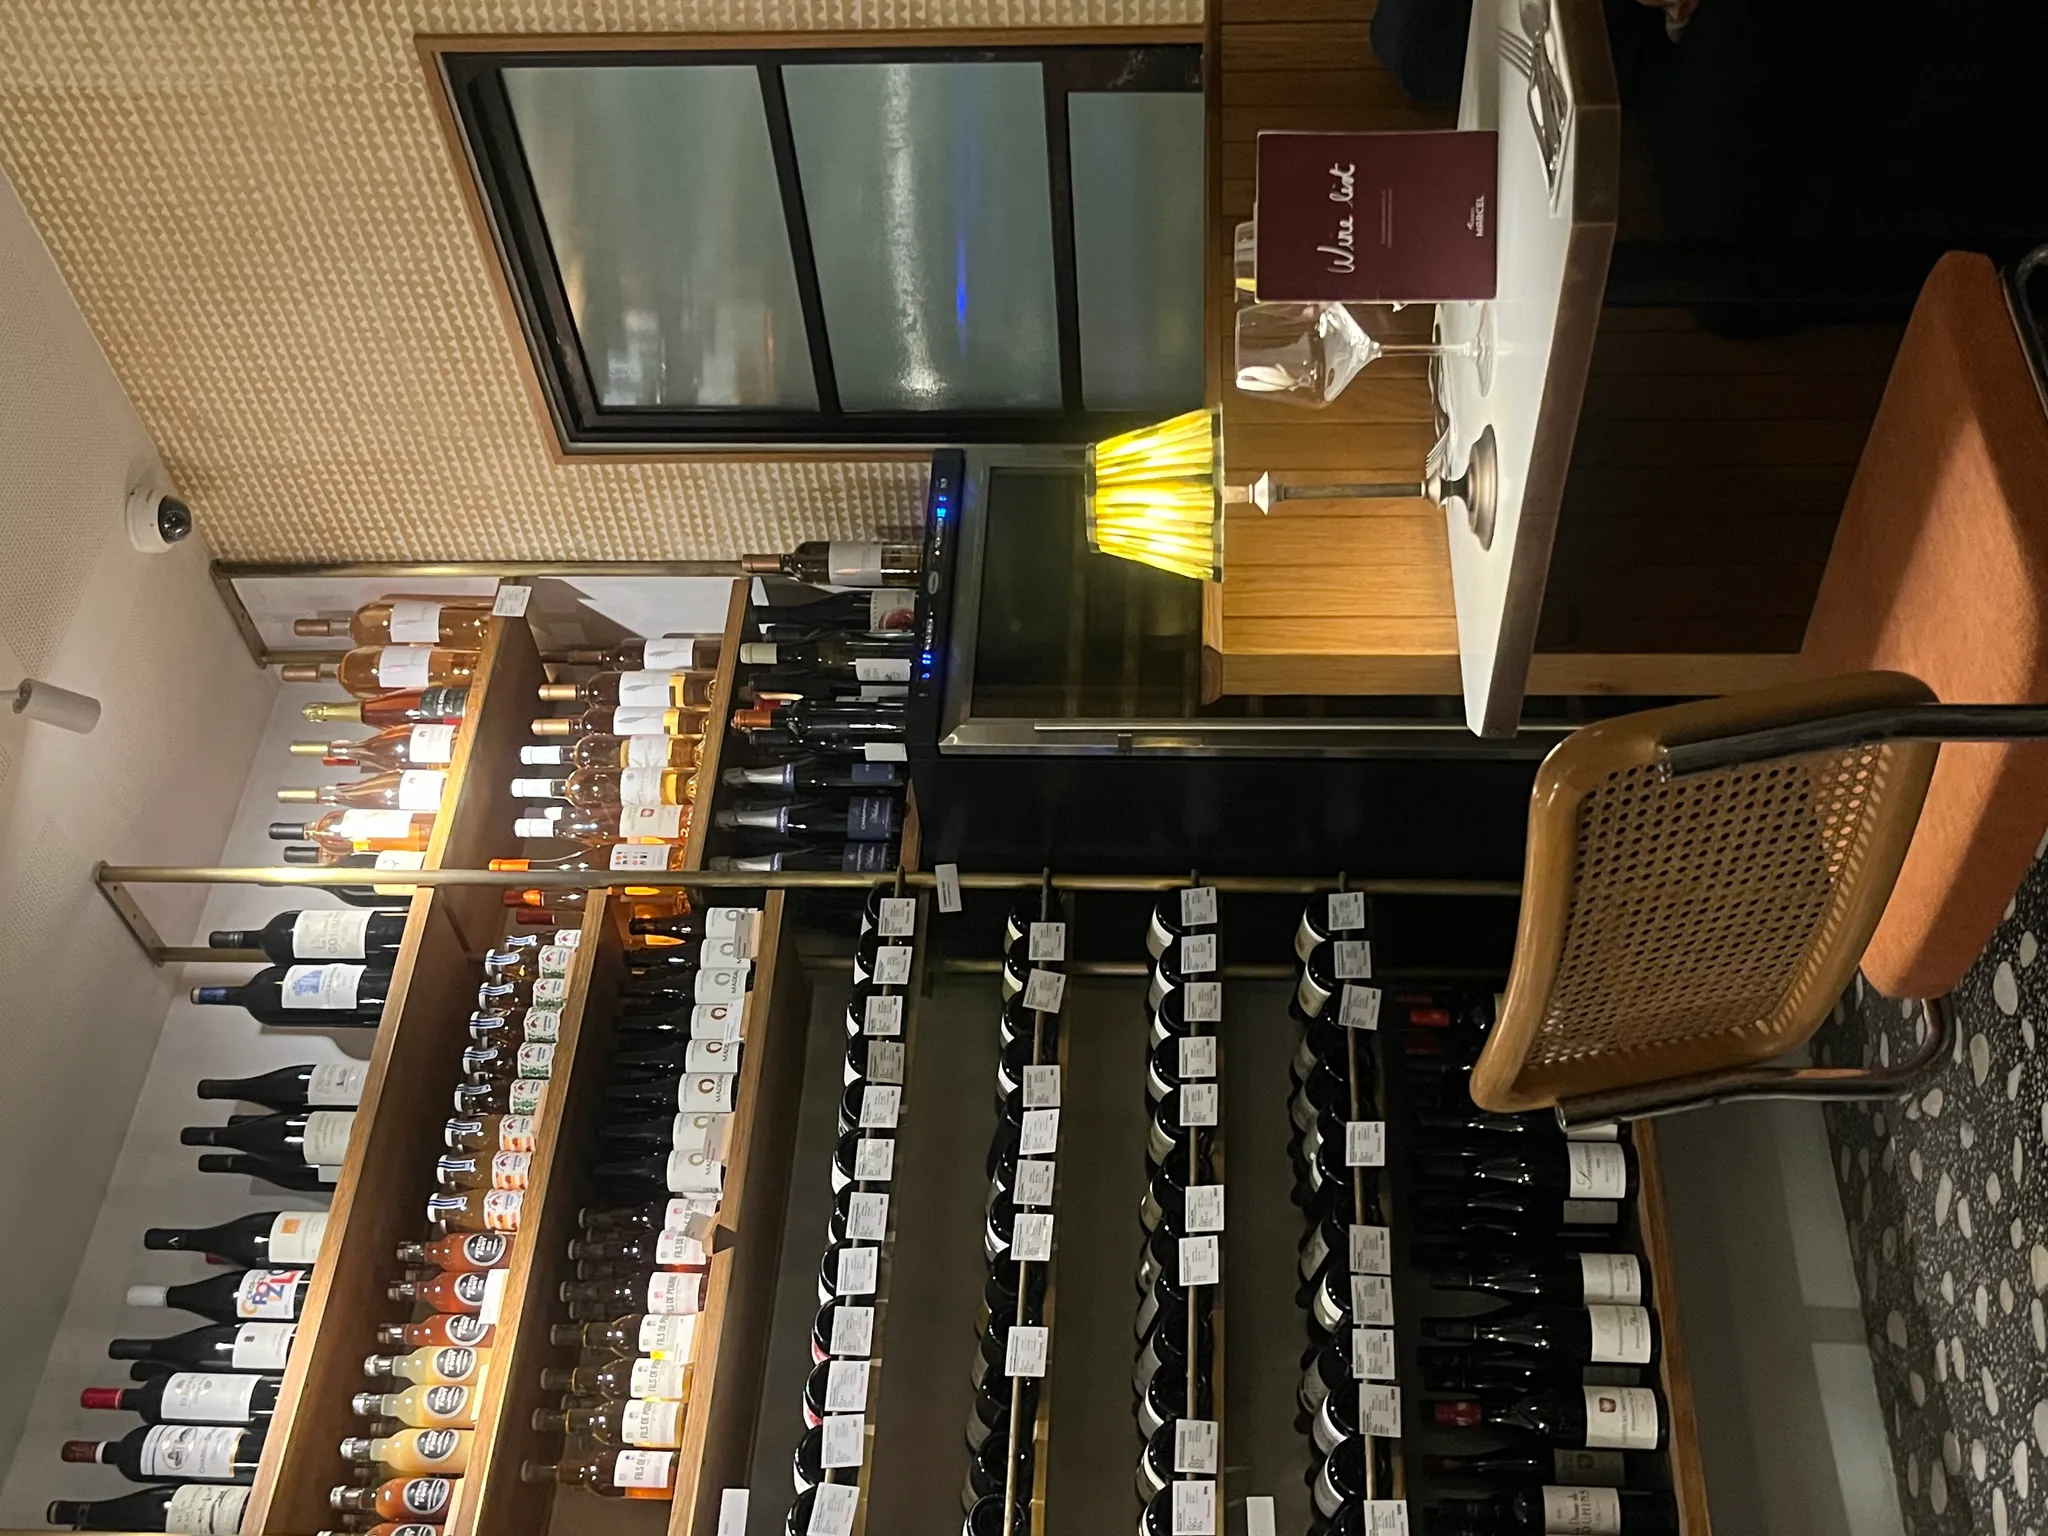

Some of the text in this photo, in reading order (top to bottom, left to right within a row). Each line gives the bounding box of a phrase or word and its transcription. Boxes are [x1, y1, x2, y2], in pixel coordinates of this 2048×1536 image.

[1316, 162, 1355, 273] Wine list
[1475, 195, 1484, 237] MARCEL
[666, 1296, 674, 1304] DE
[658, 1323, 666, 1331] DE
[656, 1333, 665, 1345] FILS
[648, 1379, 657, 1392] FILS
[641, 1416, 650, 1425] DE
[640, 1426, 649, 1438] FILS
[634, 1466, 644, 1480] FILS
